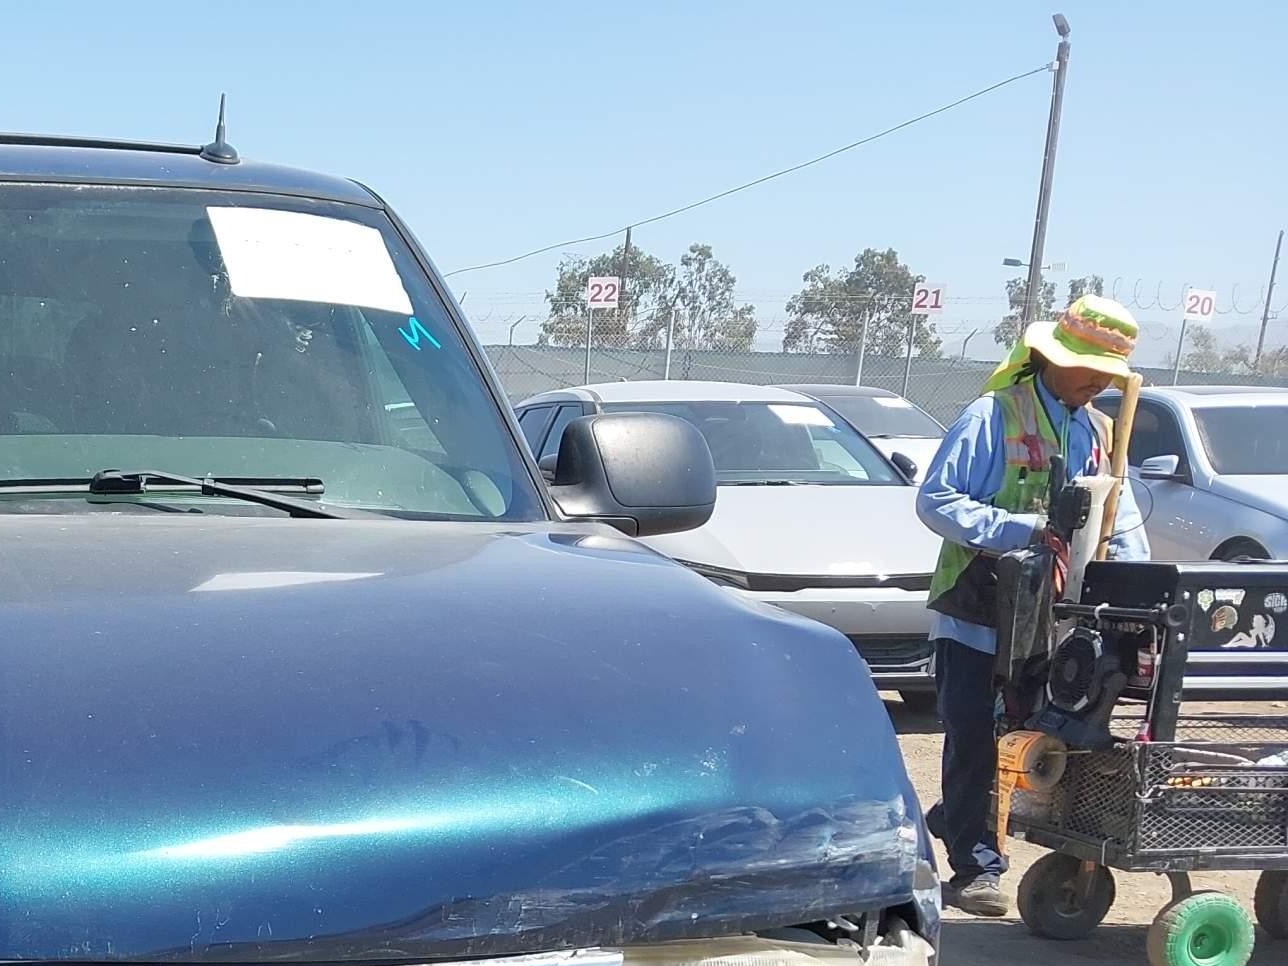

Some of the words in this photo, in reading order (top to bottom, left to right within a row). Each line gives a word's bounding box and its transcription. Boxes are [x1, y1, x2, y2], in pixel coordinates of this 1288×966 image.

[590, 283, 617, 303] 22
[914, 288, 943, 309] 21
[1186, 295, 1213, 316] 20
